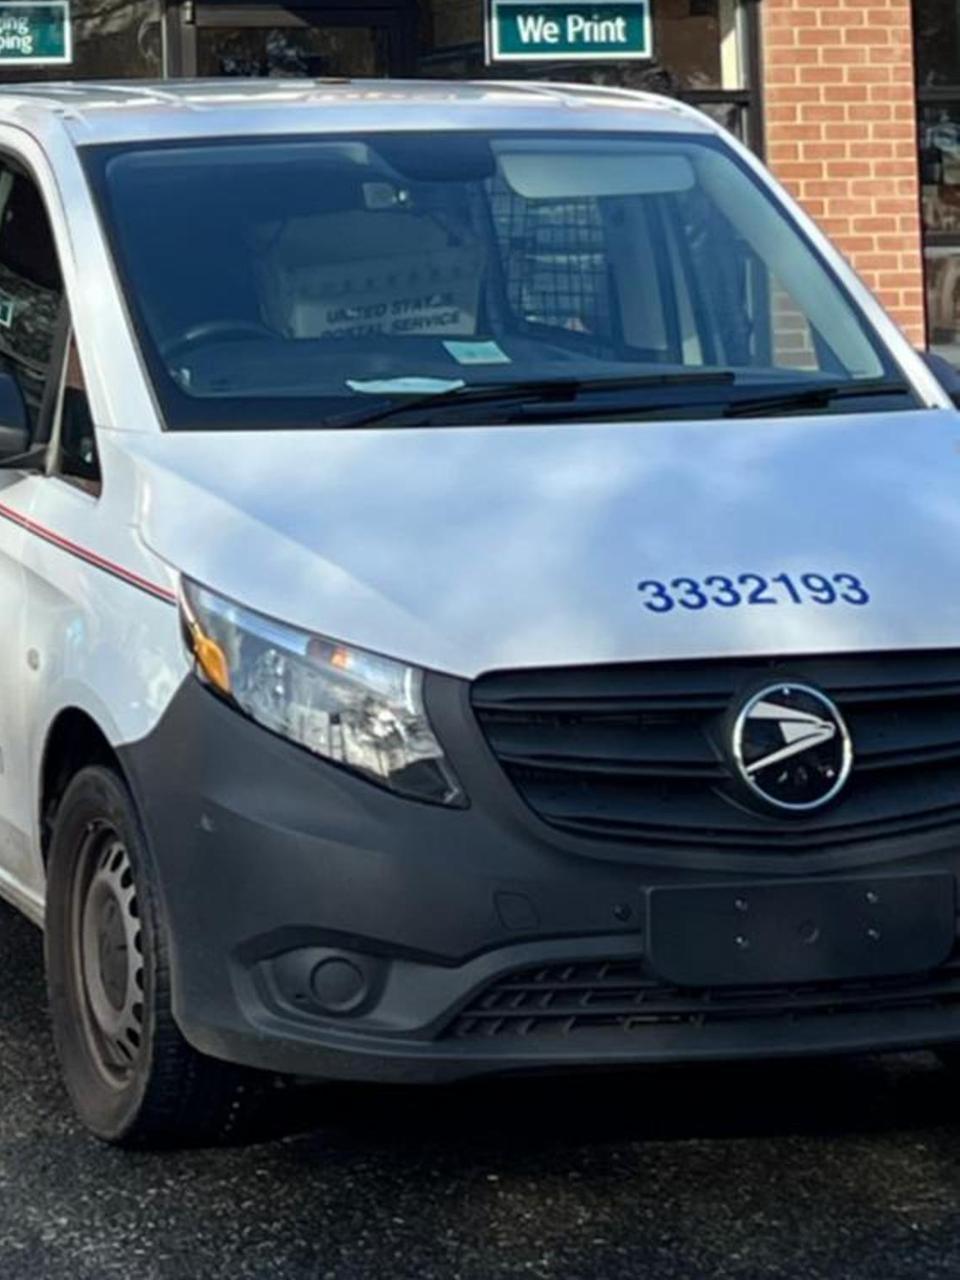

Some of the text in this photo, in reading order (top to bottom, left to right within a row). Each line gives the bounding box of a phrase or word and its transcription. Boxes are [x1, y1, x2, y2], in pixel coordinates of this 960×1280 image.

[517, 13, 627, 44] We Print
[637, 572, 870, 614] 3332193
